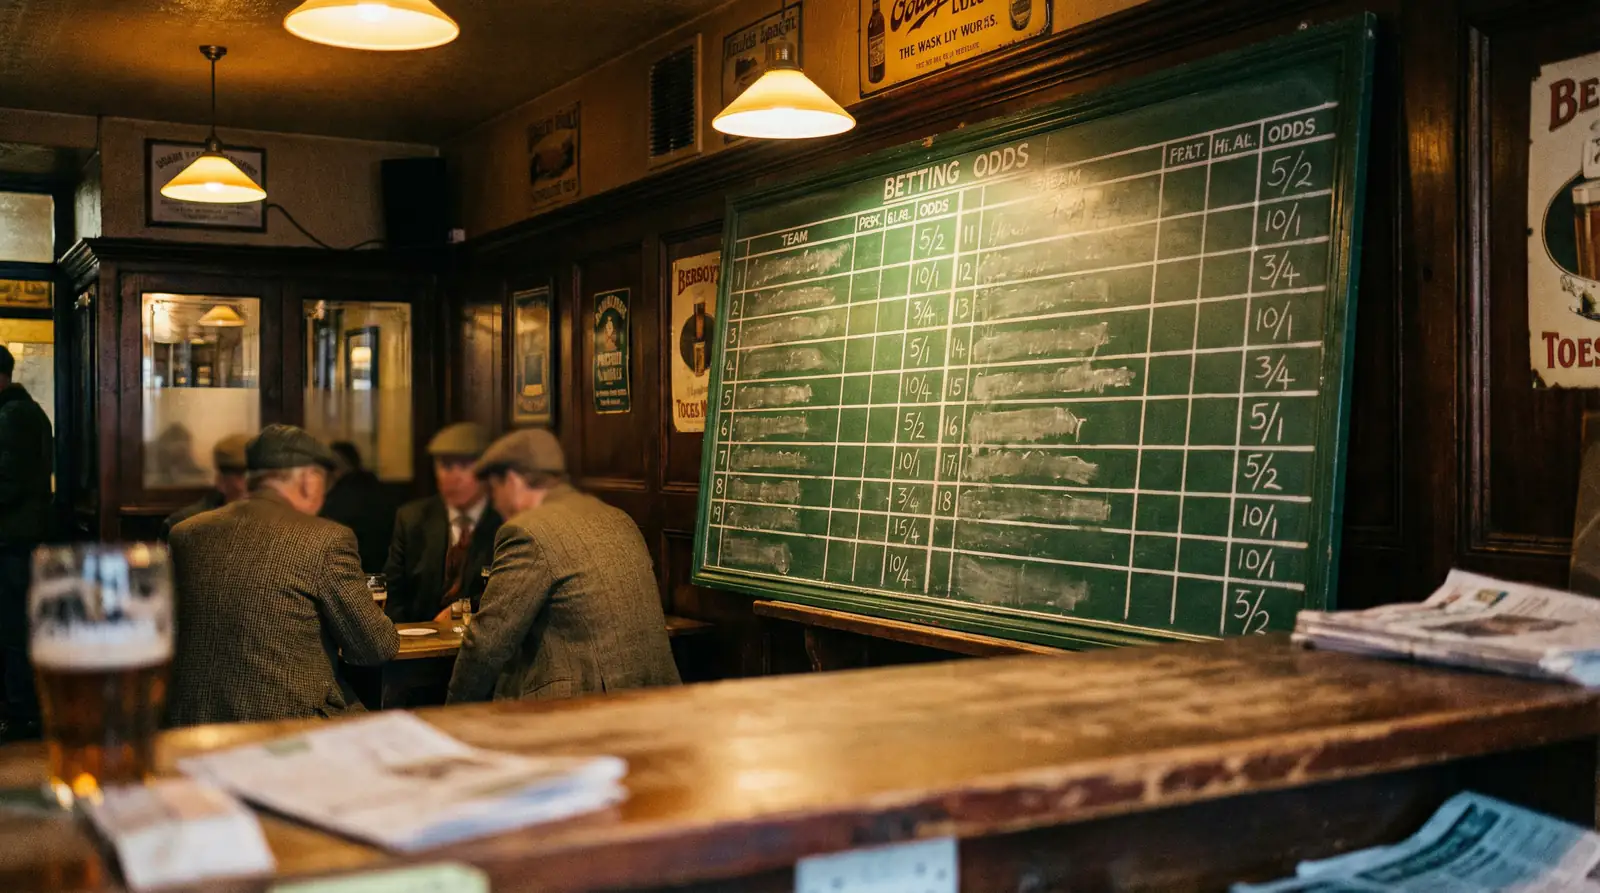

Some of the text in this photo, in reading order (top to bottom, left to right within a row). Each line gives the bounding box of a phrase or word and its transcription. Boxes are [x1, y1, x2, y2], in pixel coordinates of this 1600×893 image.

[899, 45, 915, 59] THE
[781, 230, 808, 246] TEAM
[920, 199, 949, 217] ODDS
[1268, 117, 1316, 143] ODDS
[883, 143, 1029, 200] BETTING ODDS
[919, 224, 945, 256] 5/2
[964, 225, 974, 244] 11
[1267, 150, 1313, 195] 5/2
[731, 300, 739, 316] 2
[915, 260, 939, 292] 10/1
[959, 262, 973, 282] 12
[1265, 202, 1301, 240] 10/1
[729, 250, 1301, 344] 3 3/4 13 3/4
[726, 301, 1293, 378] 4 5/1 14 10/1
[723, 389, 732, 406] 5
[905, 374, 932, 403] 10/4
[949, 377, 964, 397] 15
[1255, 354, 1295, 390] 3/4
[721, 402, 1284, 444] 6 5/2 16 5/1
[719, 450, 726, 465] 7
[898, 448, 920, 477] 10/1
[1244, 452, 1282, 492] 5/2
[716, 478, 1278, 539] 8 3/4 18 10/1
[894, 518, 920, 545] 15/4
[1238, 548, 1277, 579] 10/1
[889, 554, 1270, 635] 10/4 5/2
